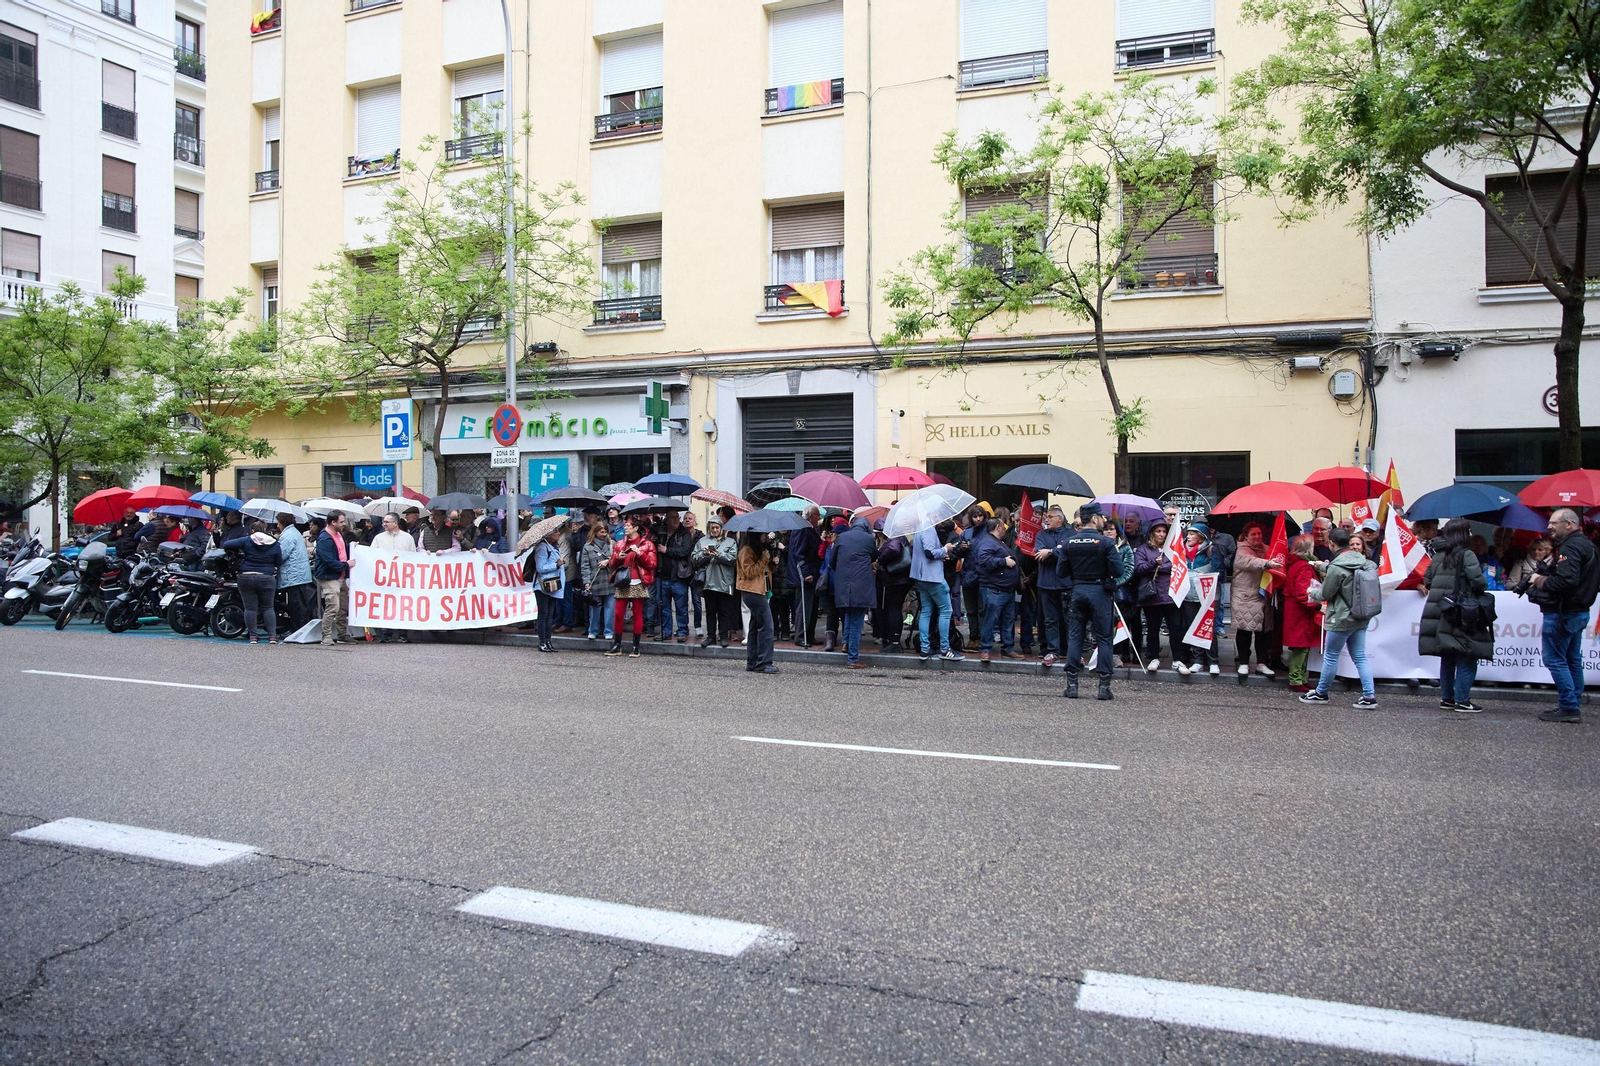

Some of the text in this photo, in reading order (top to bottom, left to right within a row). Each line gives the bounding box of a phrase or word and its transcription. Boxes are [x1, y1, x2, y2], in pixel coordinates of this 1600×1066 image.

[386, 416, 403, 446] P
[950, 424, 1050, 438] HELLO NAILS
[360, 468, 393, 485] bed's
[1180, 505, 1205, 514] UÑAS
[374, 556, 526, 590] CÁRTAMA CON
[354, 590, 430, 622] PEDRO
